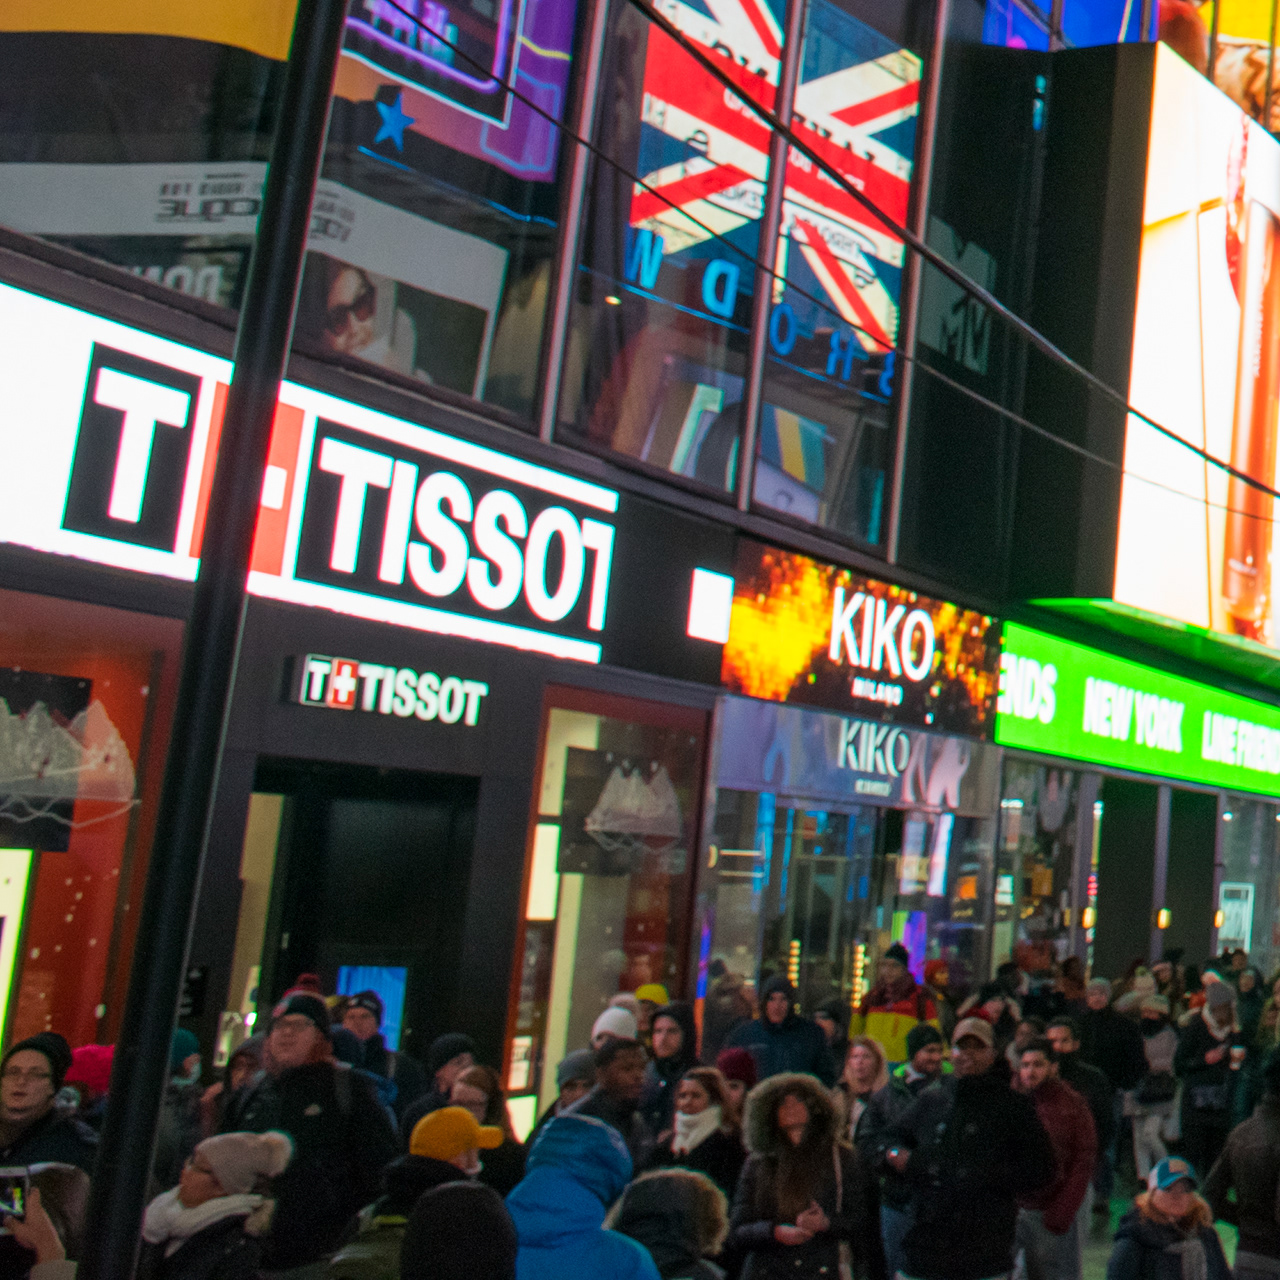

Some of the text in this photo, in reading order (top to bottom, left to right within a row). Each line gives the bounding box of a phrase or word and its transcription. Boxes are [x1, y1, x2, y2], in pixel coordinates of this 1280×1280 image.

[828, 586, 935, 682] KIKO
[358, 664, 488, 725] TISSOT
[852, 677, 904, 706] MILANO
[1083, 677, 1134, 742] NEW
[1133, 687, 1184, 753] YORK
[838, 719, 911, 777] KIKO
